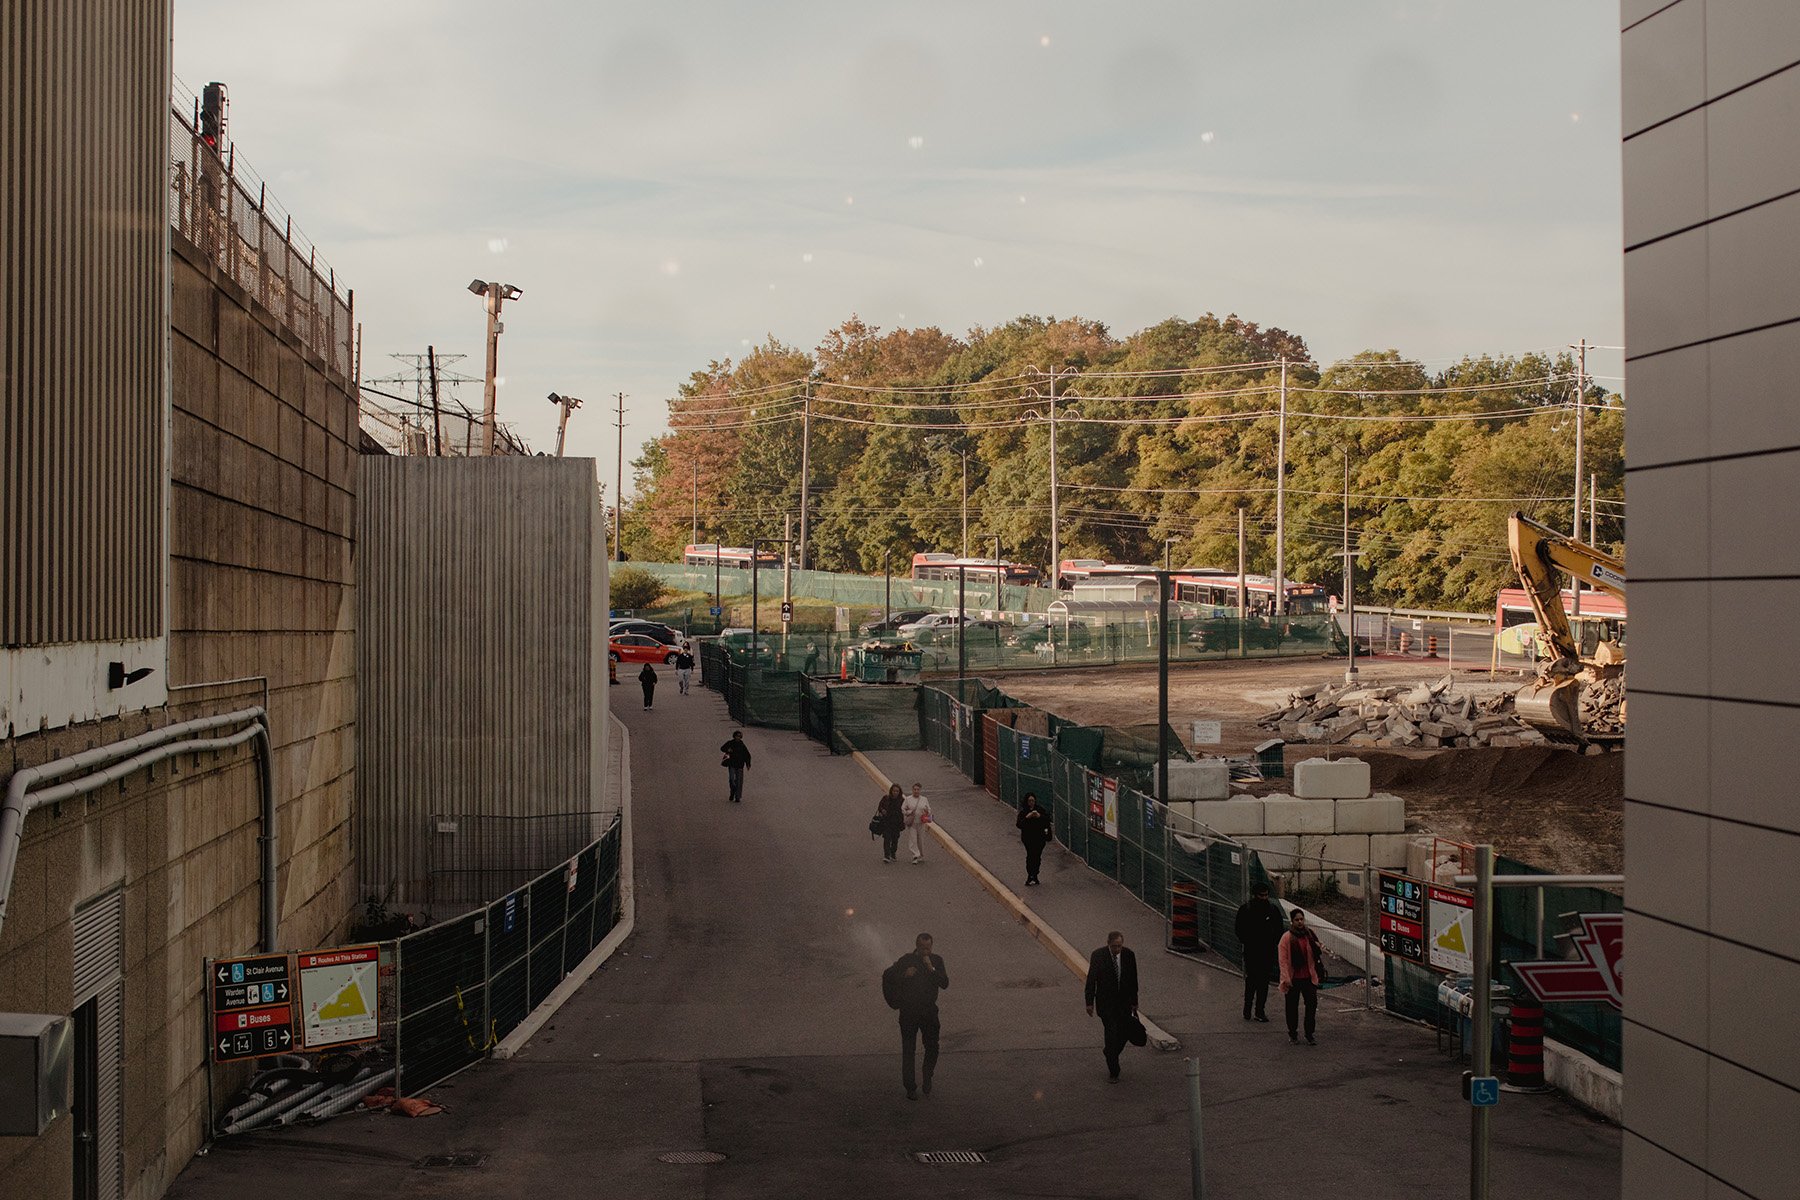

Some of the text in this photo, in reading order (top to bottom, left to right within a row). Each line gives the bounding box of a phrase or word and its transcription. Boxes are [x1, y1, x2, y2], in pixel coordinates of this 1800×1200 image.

[870, 654, 916, 664] GLOBAL
[1384, 881, 1396, 891] Subway
[1405, 902, 1420, 912] Passenger
[1397, 923, 1410, 933] Buses
[1391, 939, 1394, 949] 5
[265, 965, 284, 973] Avenue
[225, 988, 245, 996] Warden
[226, 998, 245, 1006] Avenue
[250, 1014, 271, 1024] Buses
[237, 1040, 249, 1051] 1-4
[268, 1036, 273, 1047] 5
